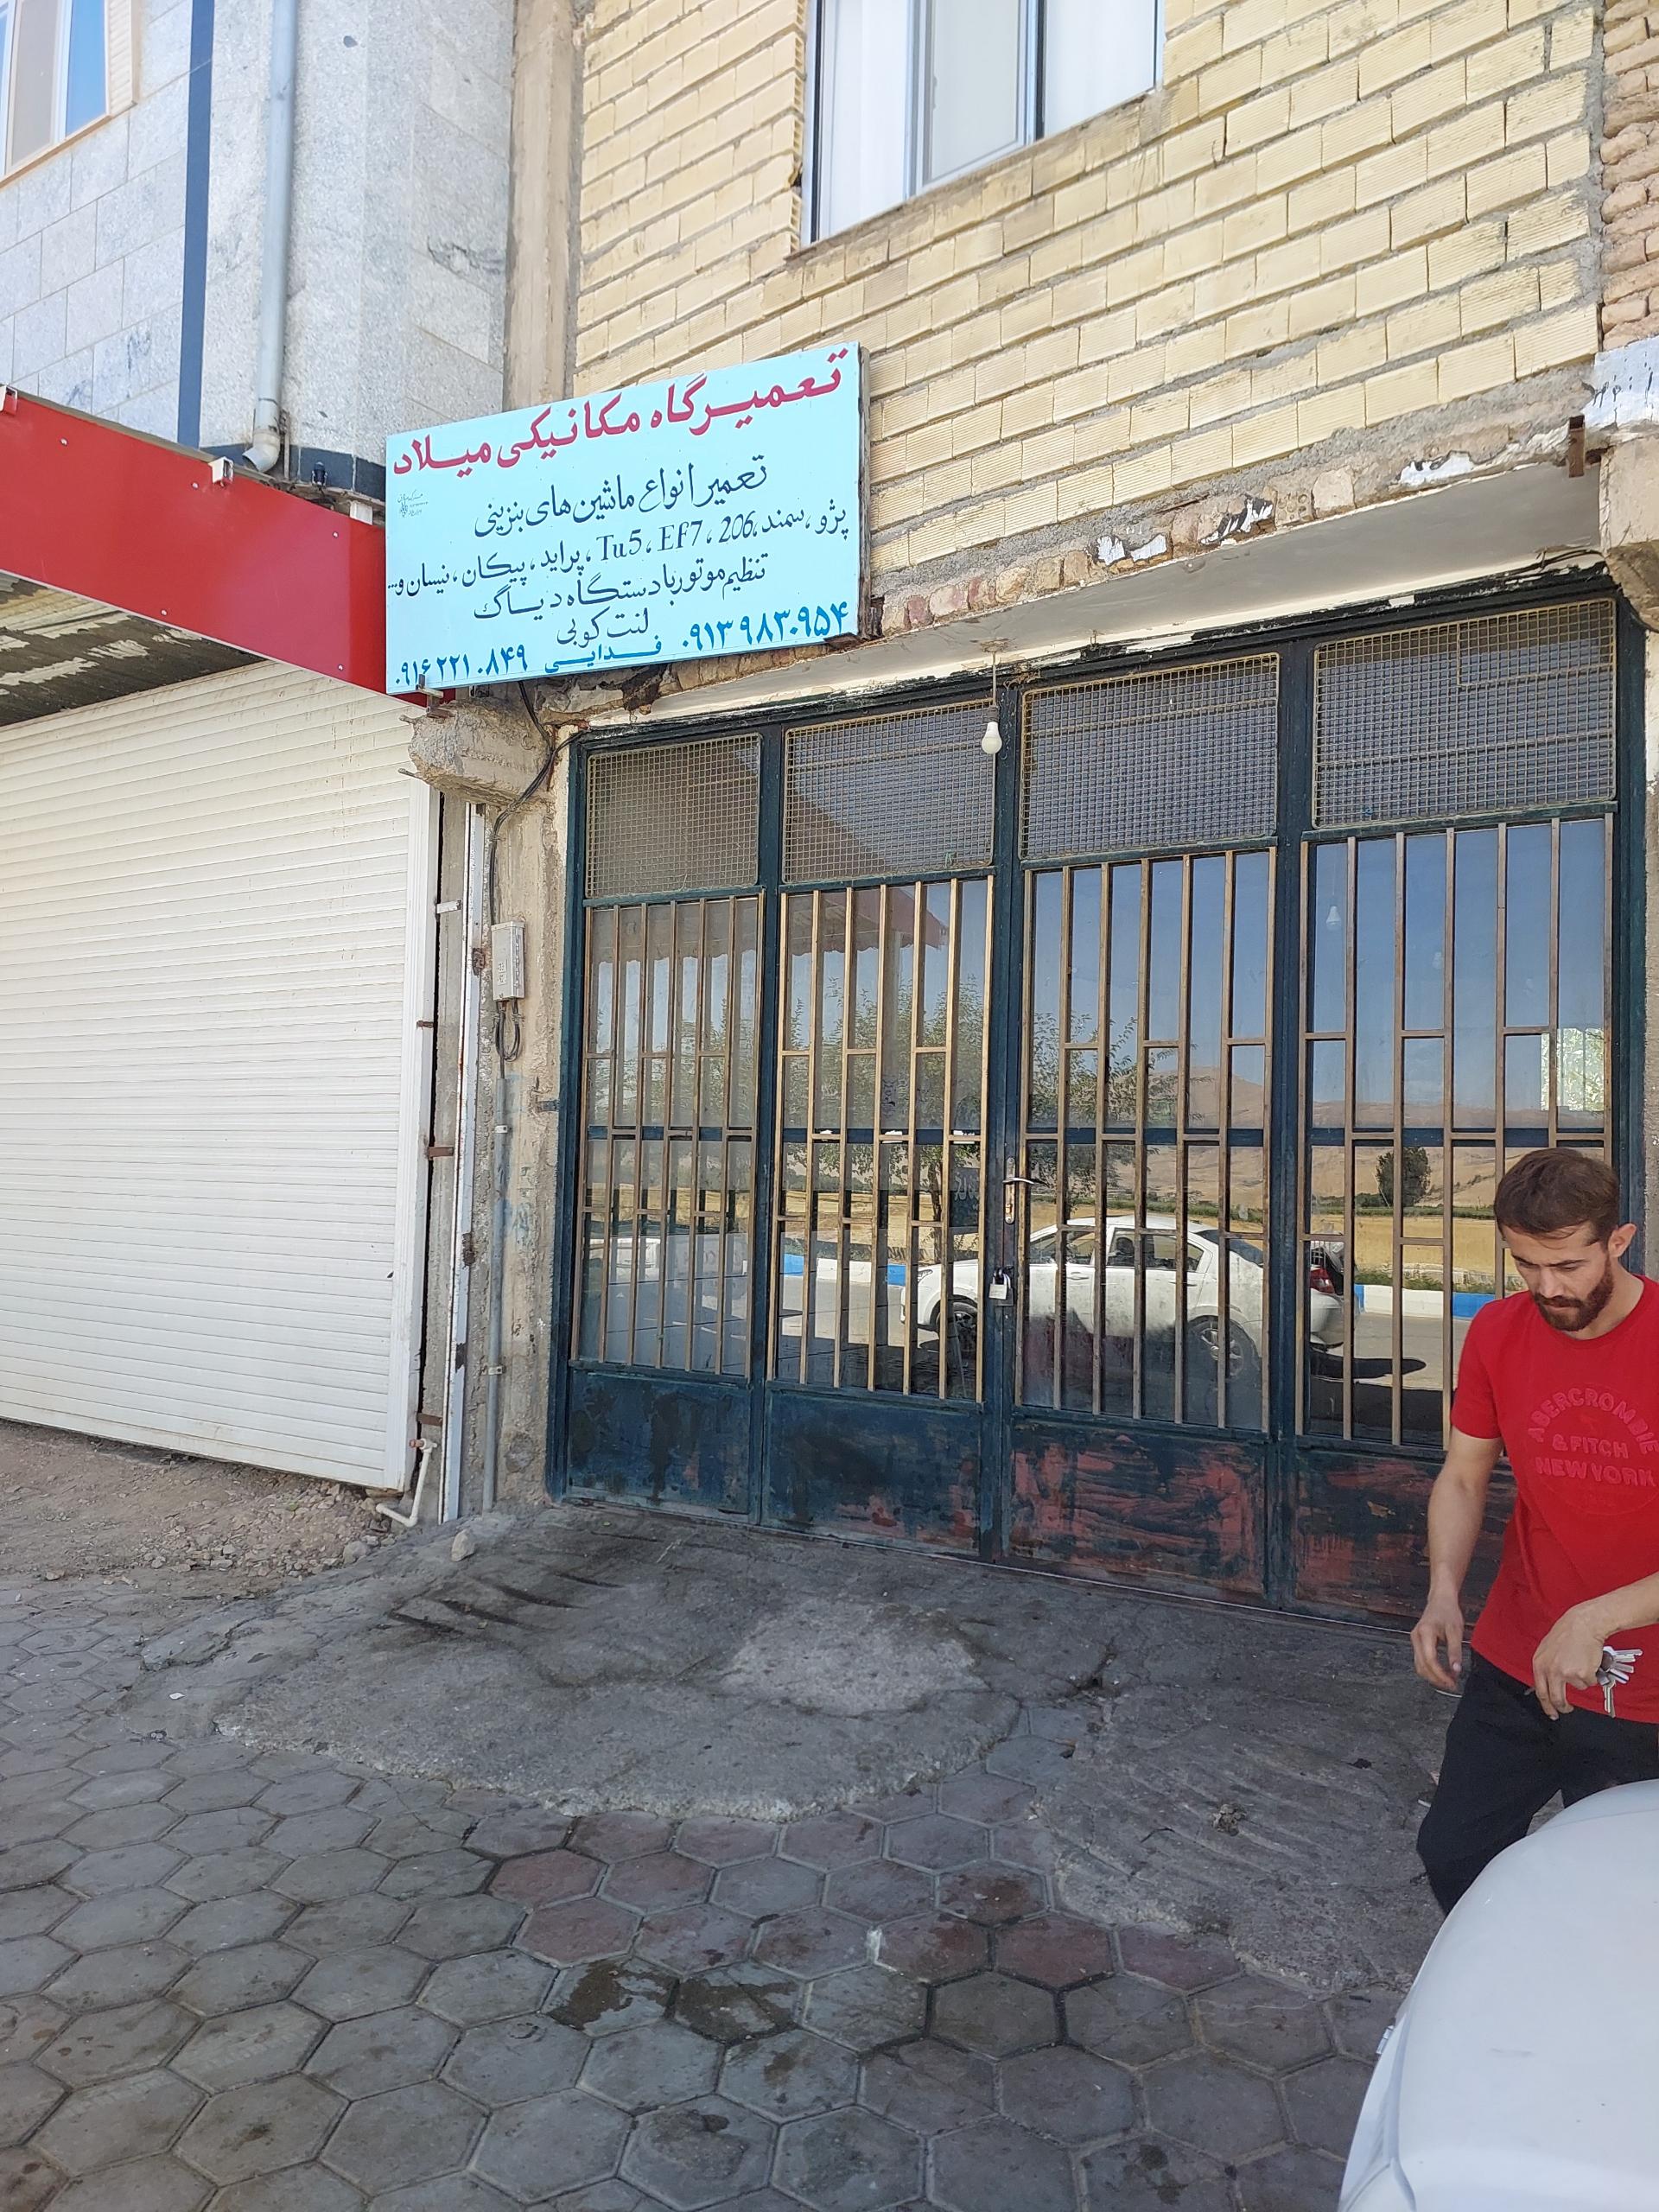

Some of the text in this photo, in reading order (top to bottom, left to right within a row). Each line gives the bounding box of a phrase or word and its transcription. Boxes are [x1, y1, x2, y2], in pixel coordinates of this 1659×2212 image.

[393, 347, 849, 478] تعمیرگاه مکانیکی میلاد
[572, 474, 635, 524] ماشین
[639, 462, 695, 513] انواع
[692, 454, 768, 508] تعمیر
[474, 500, 524, 537] بنزینی
[722, 552, 769, 601] تنظیم
[556, 606, 649, 648] لنت کوبی
[544, 634, 662, 674] فدایی
[1527, 1387, 1659, 1455] ABERCROMBIE
[1570, 1434, 1630, 1459] FITCH
[1535, 1457, 1657, 1487] NEW YORK
